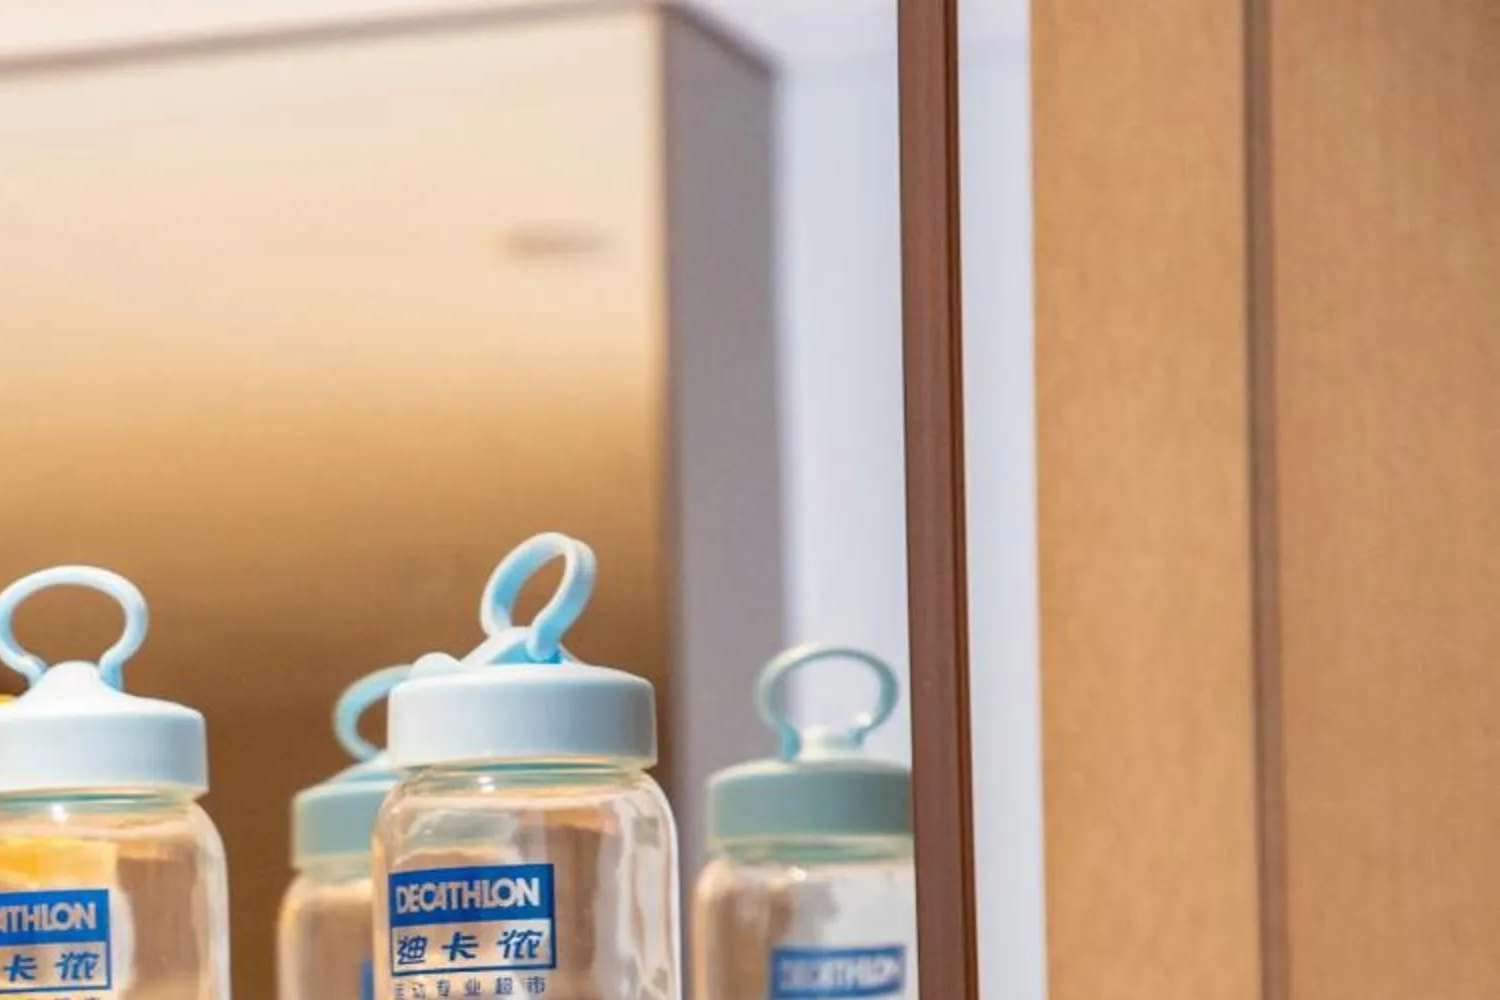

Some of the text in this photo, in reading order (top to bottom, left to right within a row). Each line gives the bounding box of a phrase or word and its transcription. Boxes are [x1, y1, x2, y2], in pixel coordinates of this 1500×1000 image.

[396, 877, 540, 914] DECATHLON
[397, 929, 543, 965] 迪卡侬
